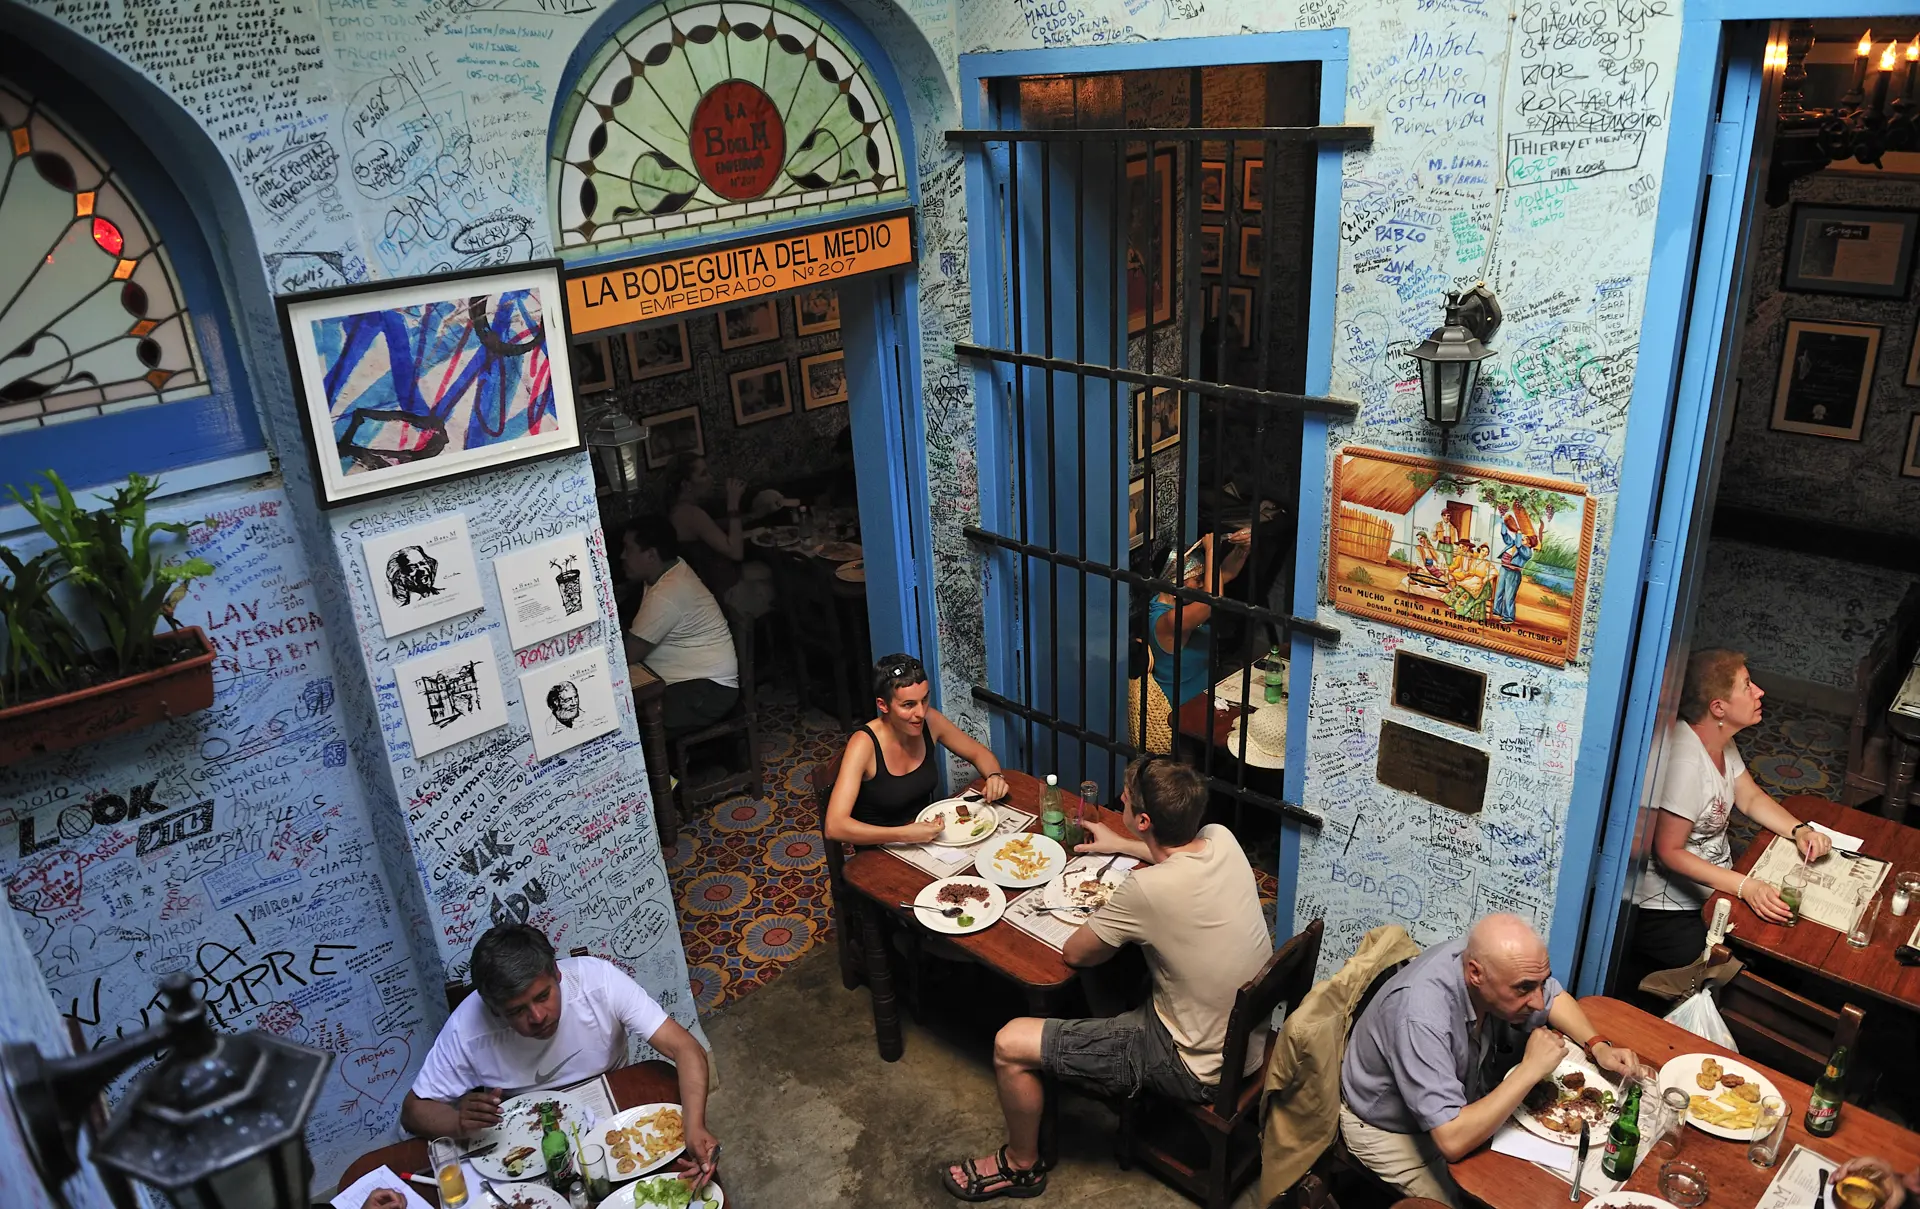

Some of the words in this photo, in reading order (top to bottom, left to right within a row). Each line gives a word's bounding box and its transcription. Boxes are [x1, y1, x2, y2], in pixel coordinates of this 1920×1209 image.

[68, 12, 112, 24] SCOTTA
[143, 7, 178, 17] PESCE
[237, 9, 265, 19] COME
[1024, 0, 1067, 26] MARCO
[1031, 9, 1085, 39] CORDOBA
[98, 30, 135, 44] LATTE
[113, 39, 157, 54] SOFFIA
[187, 43, 215, 54] DELLE
[285, 34, 316, 44] BASTA
[207, 52, 226, 64] PER
[251, 69, 271, 80] CHE
[270, 76, 300, 88] COME
[724, 102, 747, 121] LA
[218, 122, 248, 141] MARE
[1509, 137, 1576, 162] THIERRY
[1578, 137, 1592, 149] ET
[1595, 132, 1642, 146] HENRY
[1390, 207, 1442, 225] MADRID
[1375, 225, 1427, 243] PABLO
[582, 276, 618, 308] LA
[622, 247, 769, 300] BODEGUITA
[774, 239, 818, 269] DEL
[824, 223, 891, 259] MEDIO
[640, 274, 776, 316] EMPEDRADO
[818, 257, 856, 277] 207
[1471, 427, 1511, 444] CULE
[480, 521, 563, 560] SAHUAYO
[284, 599, 305, 611] 2010
[1366, 602, 1392, 613] DONADO
[1338, 585, 1352, 595] CON
[1357, 589, 1385, 602] MUCHO
[1394, 598, 1424, 611] CARIÑO
[1431, 608, 1442, 616] AL
[1478, 620, 1511, 633] CUBANO
[1551, 637, 1563, 646] 95
[1501, 682, 1541, 701] CIP
[266, 794, 327, 827] ALEXIS
[433, 842, 469, 881] CHILE
[476, 795, 508, 833] CUBA
[309, 849, 364, 879] CHARLY
[311, 872, 369, 899] ESPAÑA
[287, 905, 345, 932] YAIMARA
[305, 916, 352, 934] TORRES
[354, 1047, 396, 1068] THOMAS
[367, 1068, 398, 1084] LUPITA
